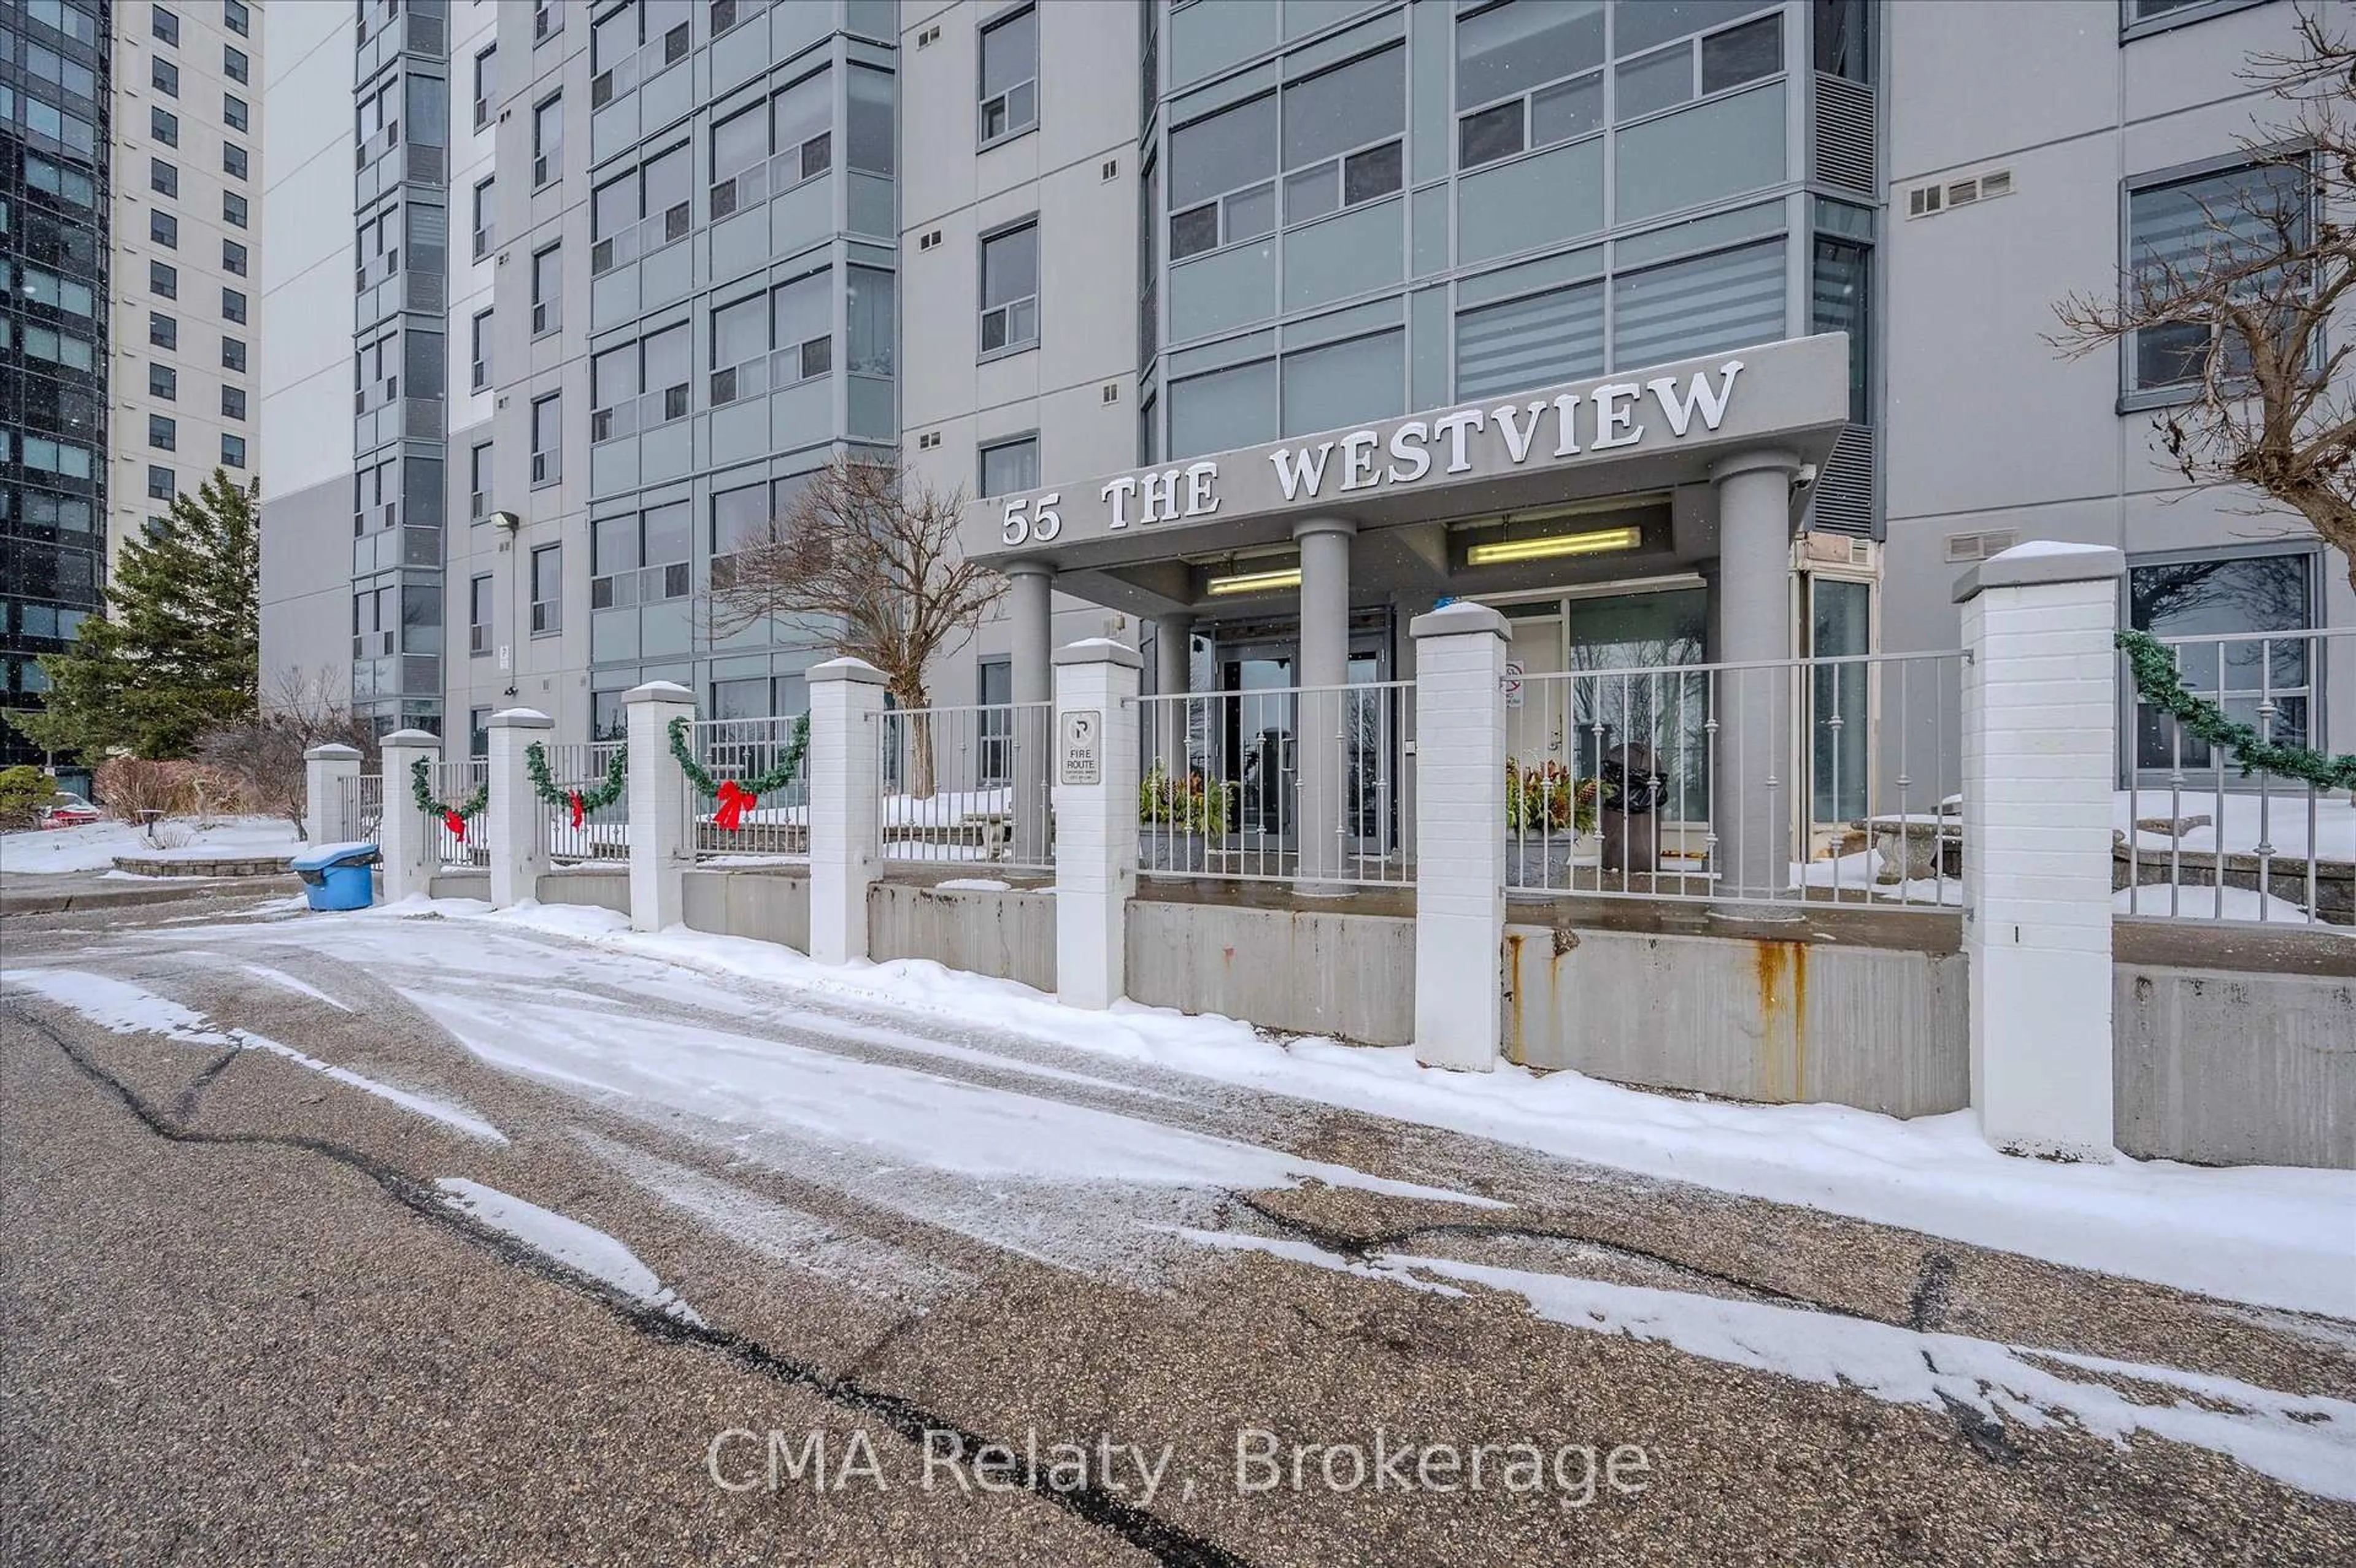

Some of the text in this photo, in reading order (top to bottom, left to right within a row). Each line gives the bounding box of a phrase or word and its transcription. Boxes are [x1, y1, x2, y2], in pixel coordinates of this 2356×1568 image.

[1003, 360, 1745, 545] 55 THE WESTVIEW
[1070, 749, 1091, 758] FIRE
[1067, 760, 1095, 769] ROUTE
